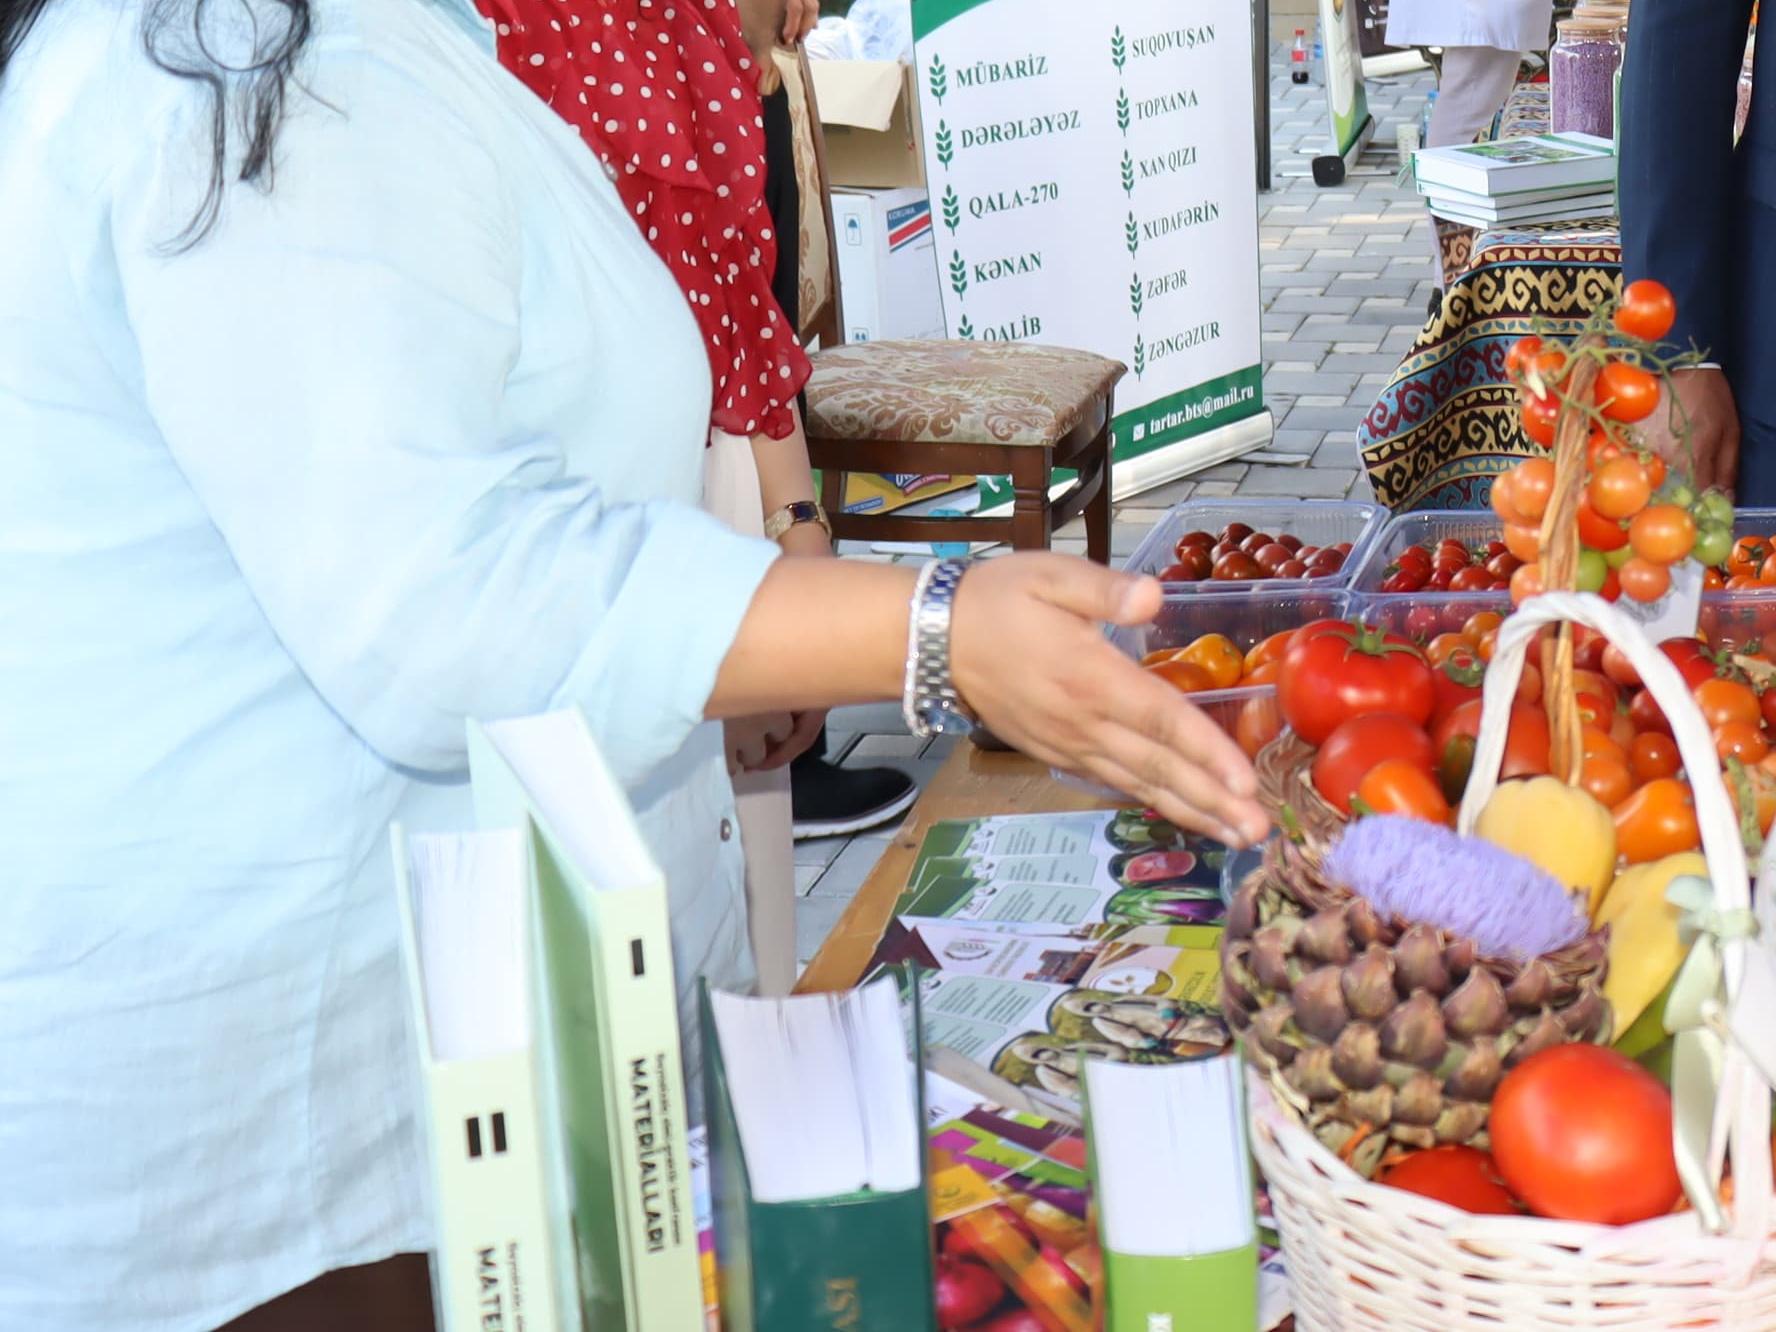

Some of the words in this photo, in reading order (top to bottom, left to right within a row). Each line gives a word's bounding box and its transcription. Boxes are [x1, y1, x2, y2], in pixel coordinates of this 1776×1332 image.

[1132, 24, 1215, 58] SUQOVUŞAN
[956, 53, 1048, 88] MÜBARİZ
[1136, 89, 1198, 120] TOPXANA
[960, 109, 1081, 149] DƏRƏLƏYƏZ
[1139, 155, 1165, 179] XAN
[1168, 146, 1197, 172] QIZI
[969, 181, 1058, 219] QALA-270
[1143, 199, 1219, 241] XUDAFƏRİN
[973, 251, 1042, 283] KƏNAN
[1146, 269, 1187, 299] ZƏFƏR
[1148, 321, 1220, 362] ZƏNGƏZUR
[1150, 385, 1255, 435] tartar.bts@mail.ru
